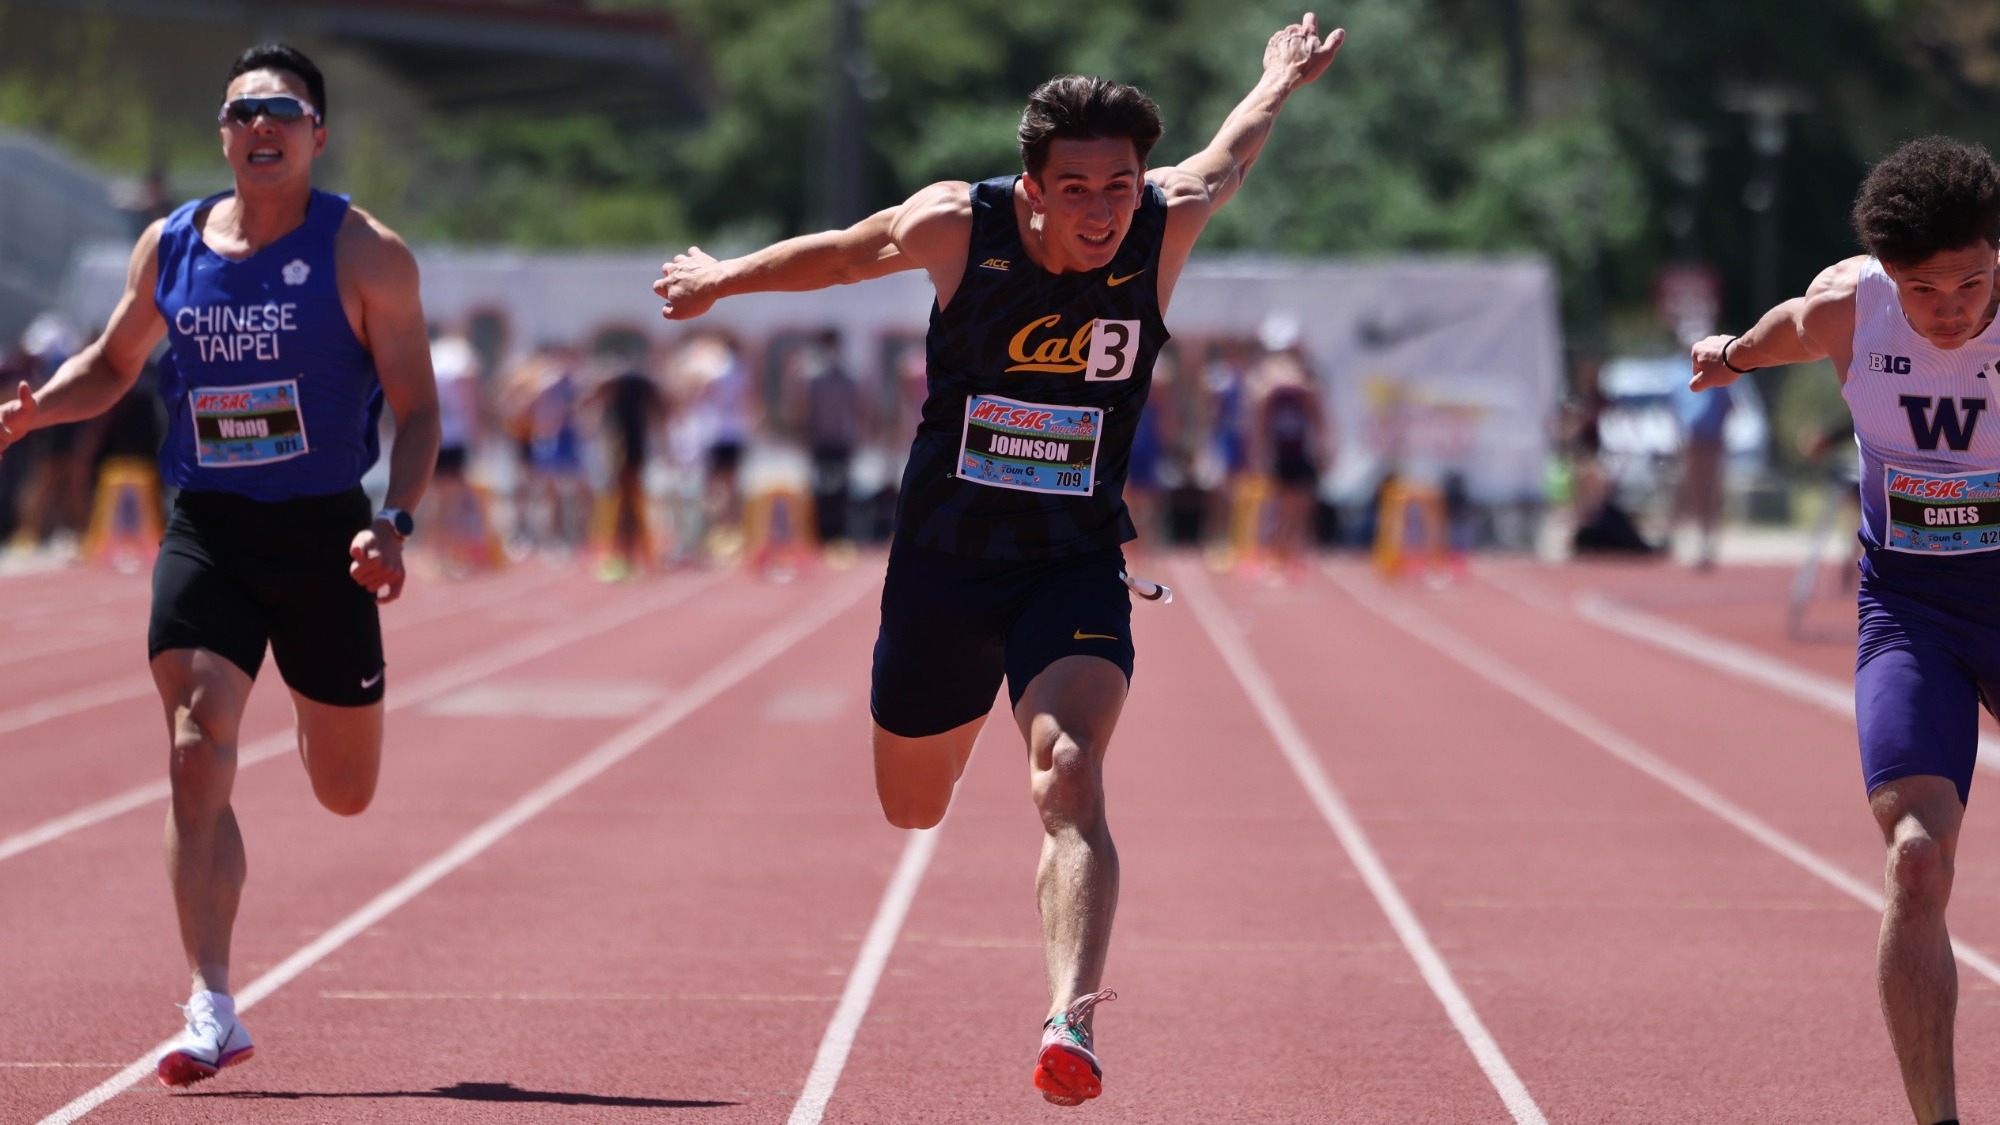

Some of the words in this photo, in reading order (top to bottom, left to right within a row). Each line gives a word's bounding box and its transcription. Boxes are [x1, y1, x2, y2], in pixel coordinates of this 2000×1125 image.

[982, 258, 1011, 270] ACC
[176, 303, 297, 335] CHINESE
[193, 333, 280, 362] TAIPEI
[1005, 314, 1098, 372] Cal
[1095, 323, 1130, 378] 3
[218, 417, 269, 438] Wang
[1049, 425, 1096, 437] RELAYS
[1898, 393, 1987, 451] W
[274, 439, 298, 454] 971
[988, 434, 1070, 462] JOHNSON
[1056, 471, 1083, 487] 709
[1967, 489, 2000, 499] RELA
[1923, 506, 1980, 526] CATES
[1980, 530, 2000, 545] 42
